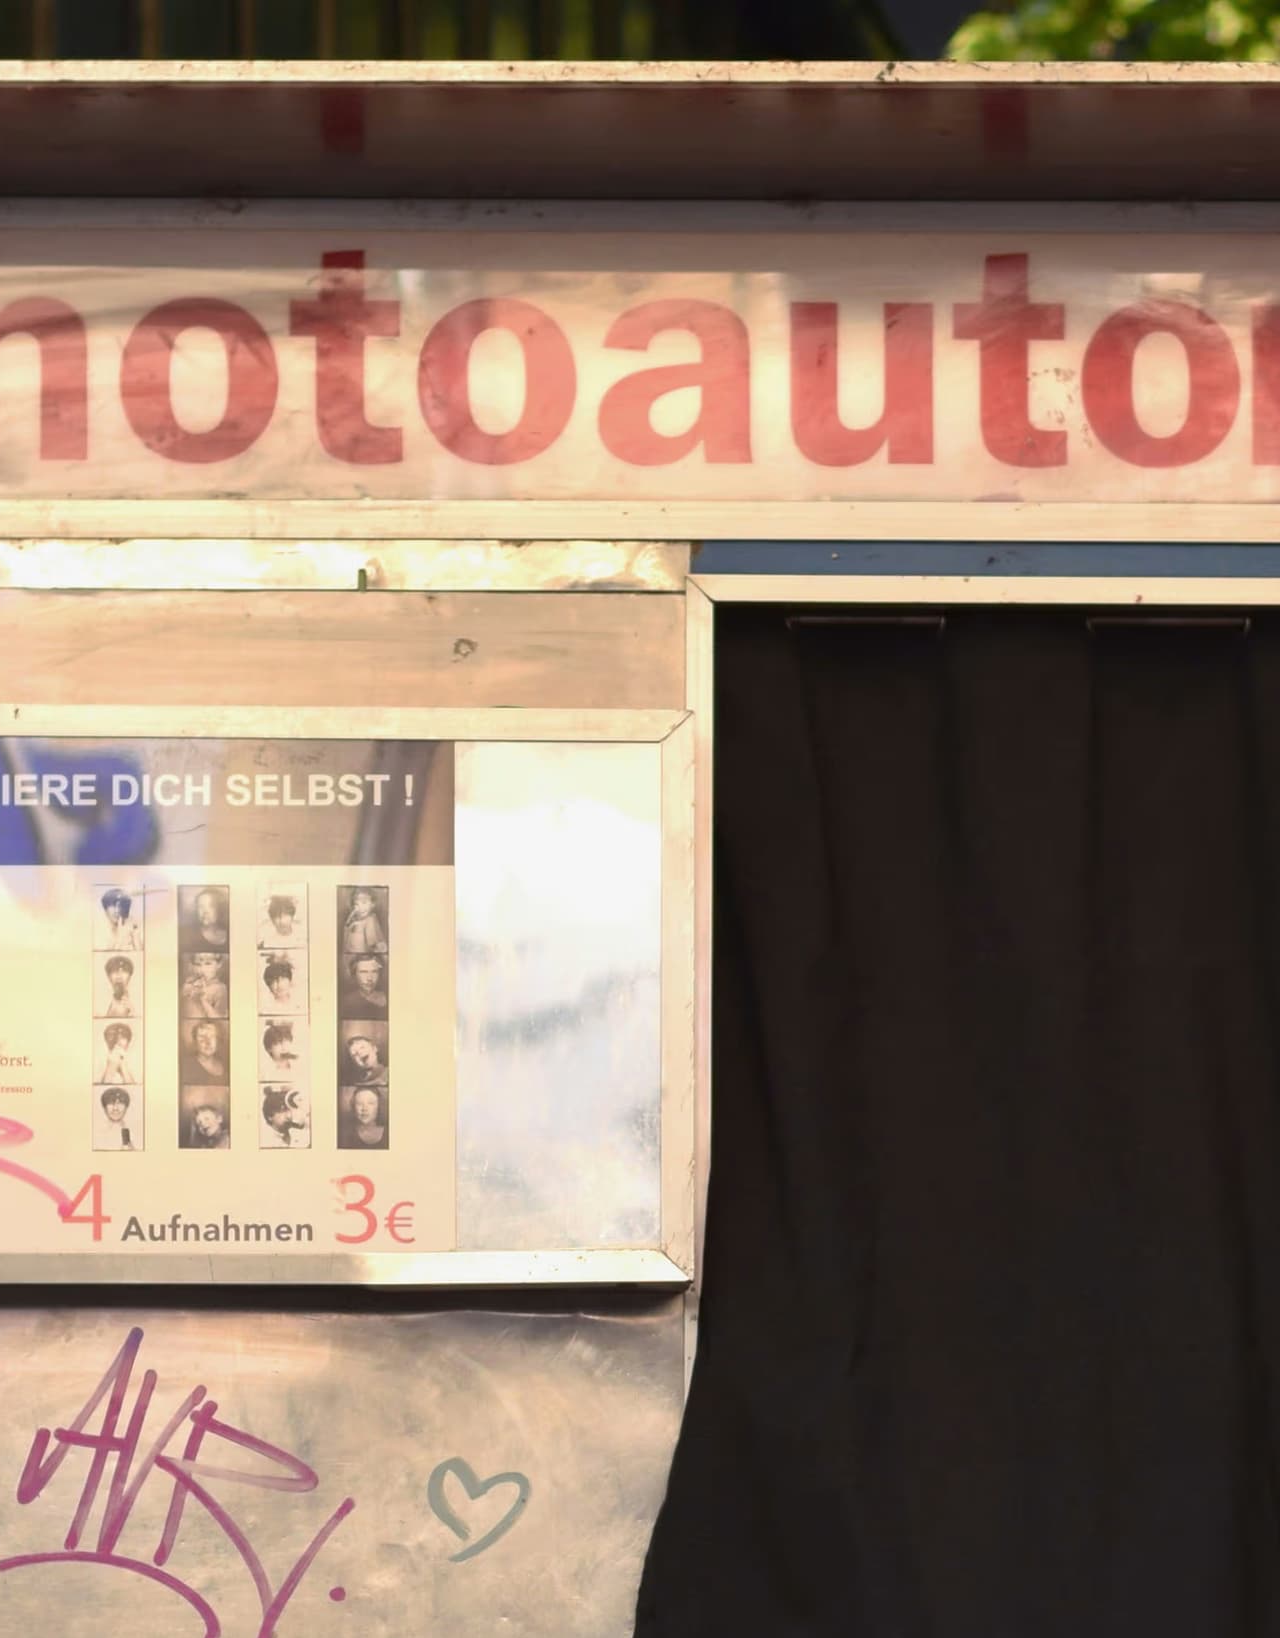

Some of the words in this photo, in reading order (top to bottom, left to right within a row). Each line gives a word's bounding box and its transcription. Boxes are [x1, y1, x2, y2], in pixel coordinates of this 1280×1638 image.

[112, 774, 211, 807] DICH
[226, 774, 390, 807] SELBST
[405, 774, 414, 807] !
[61, 1174, 111, 1242] 4
[121, 1214, 313, 1242] Aufnahmen
